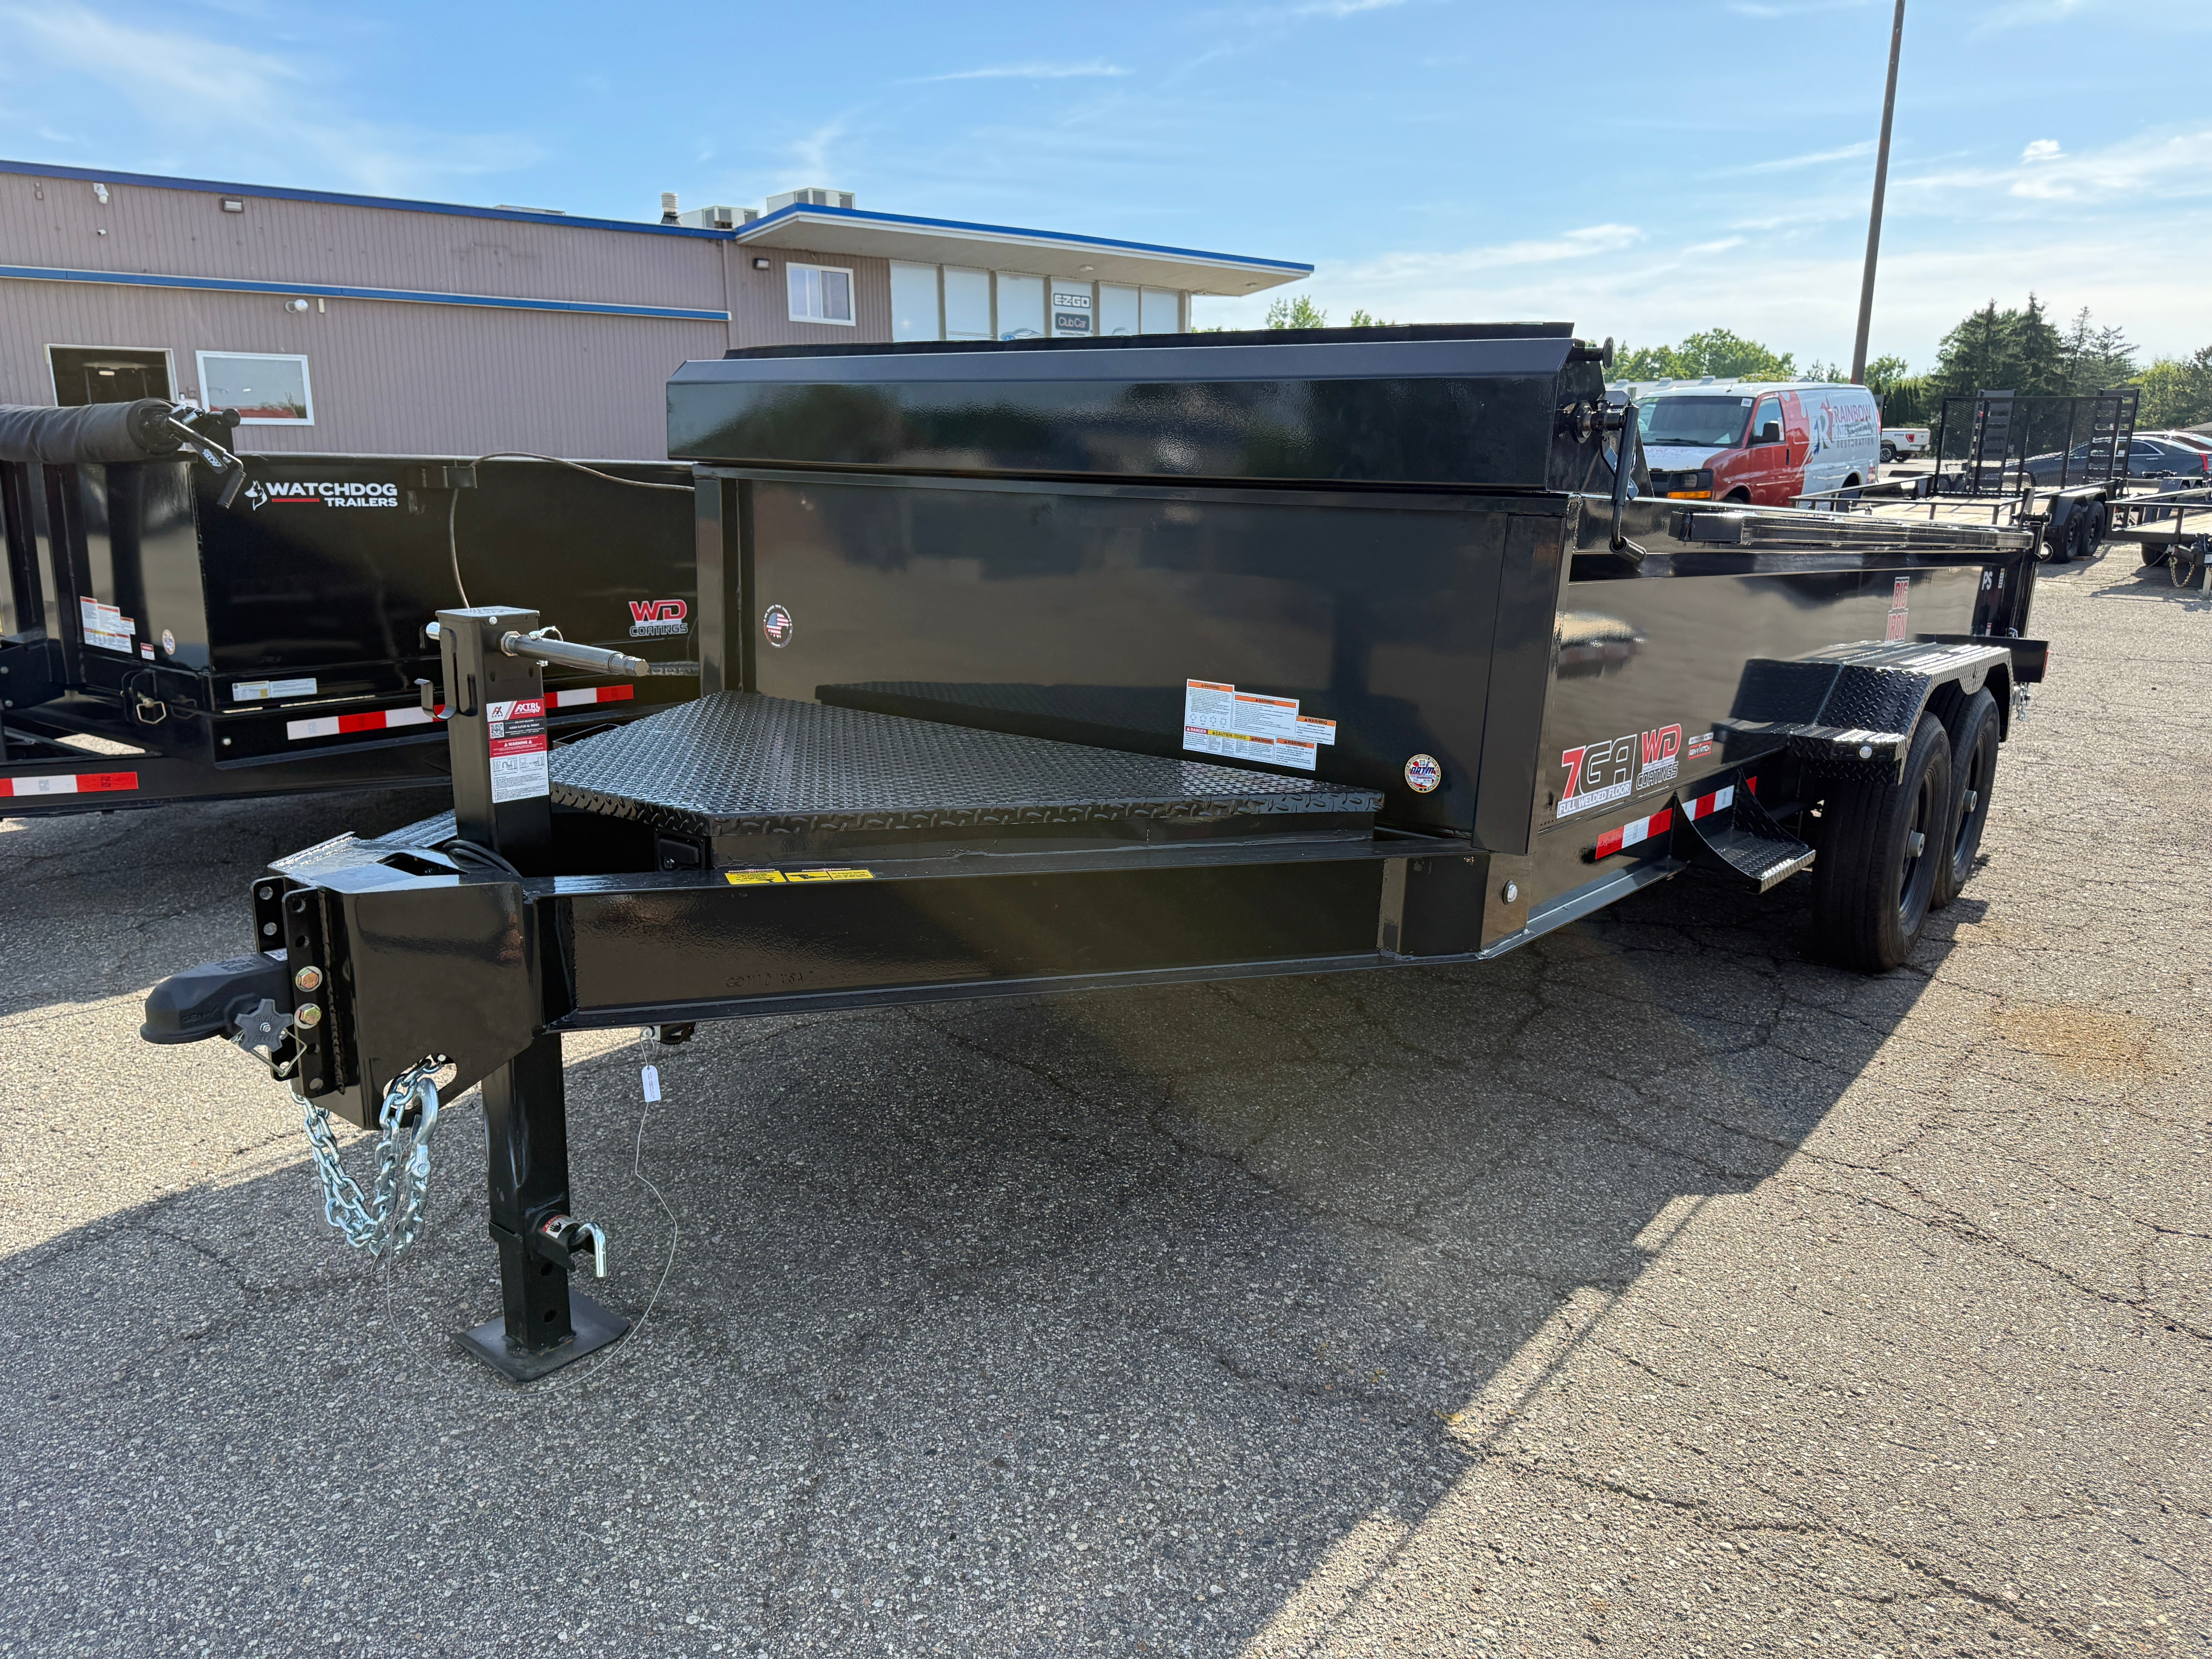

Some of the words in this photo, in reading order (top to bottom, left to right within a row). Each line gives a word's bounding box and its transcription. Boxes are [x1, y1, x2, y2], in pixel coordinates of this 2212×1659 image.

[1058, 316, 1074, 327] Club
[1074, 318, 1087, 328] Car
[1833, 404, 1871, 423] RAINBOW
[266, 482, 398, 496] WATCHDOG
[325, 497, 398, 507] TRAILERS
[1982, 571, 1993, 591] PS
[1892, 581, 1909, 610] BIG
[629, 599, 687, 622] WD
[629, 623, 688, 637] COATINGS
[1886, 612, 1908, 642] IRON
[1642, 723, 1682, 764] WD
[1636, 761, 1679, 790] COATINGS
[1559, 800, 1577, 815] FULL
[1578, 791, 1606, 807] WELDED
[1607, 784, 1630, 800] FLOOR
